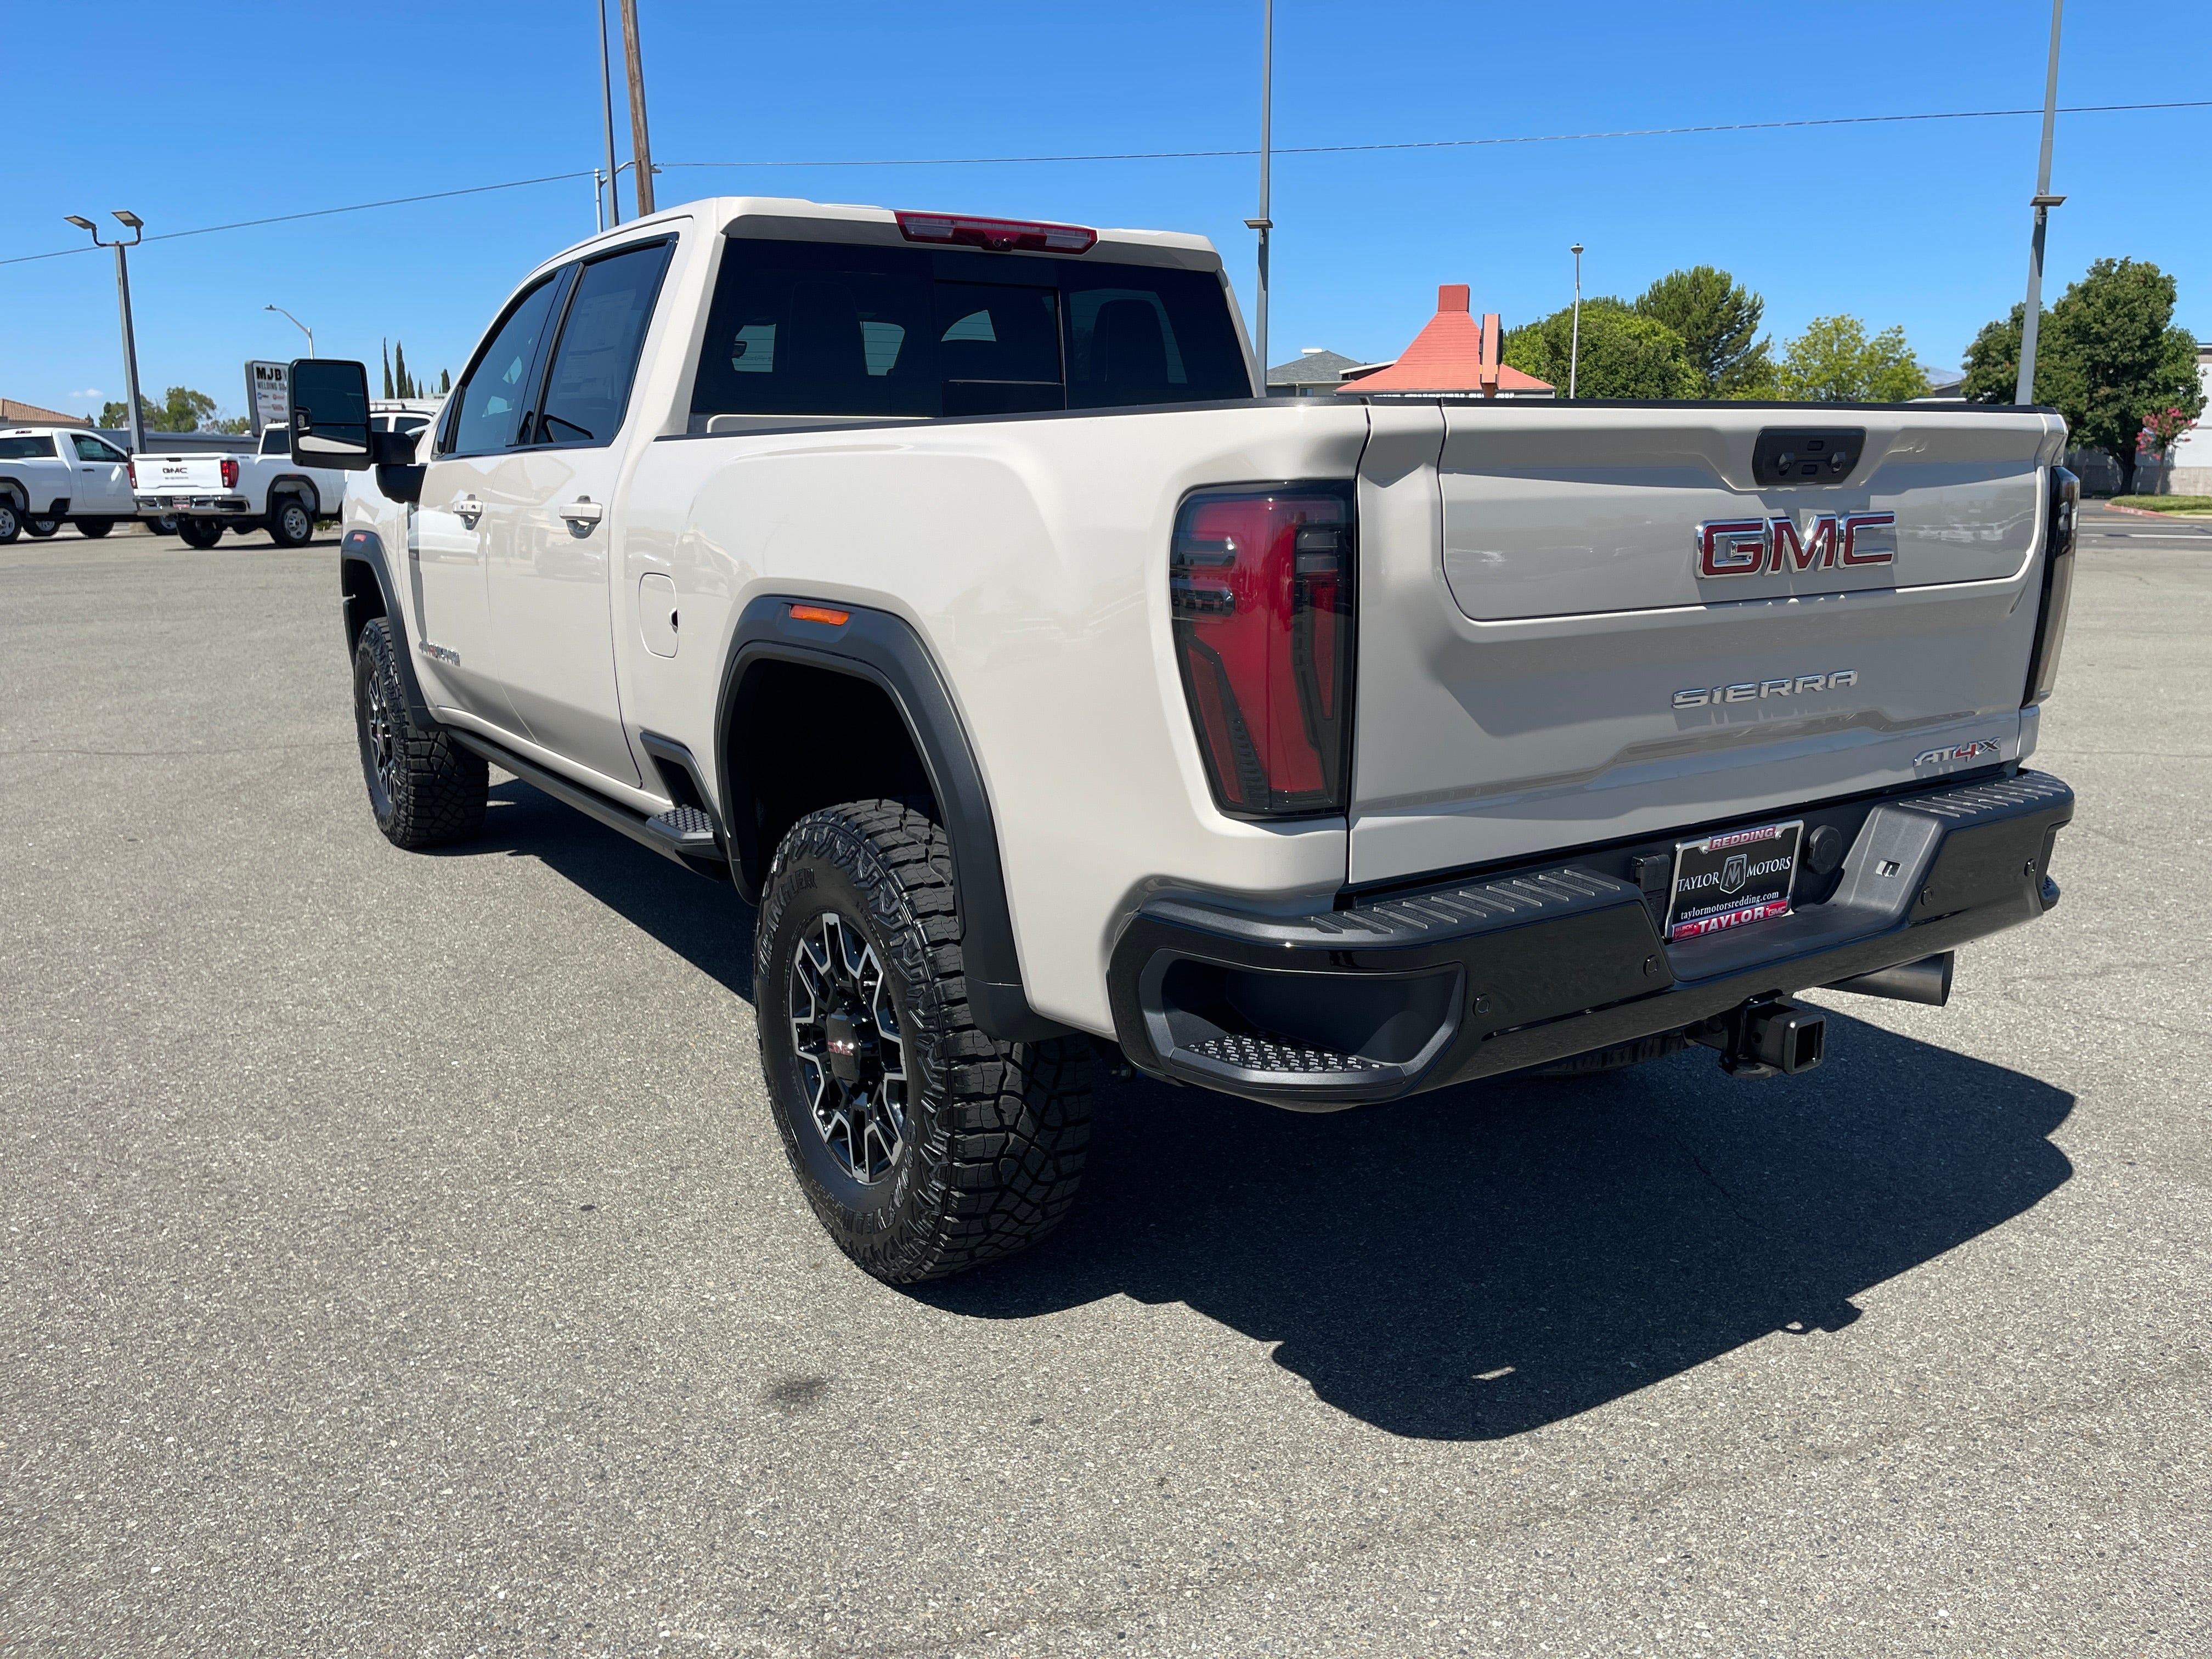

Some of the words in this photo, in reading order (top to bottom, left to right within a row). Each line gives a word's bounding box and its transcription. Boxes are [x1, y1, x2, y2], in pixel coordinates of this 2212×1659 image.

[256, 366, 281, 380] MJB
[1695, 511, 1895, 579] GMC
[1672, 669, 1858, 709] SIERRA
[1914, 737, 2001, 767] AT4X
[1711, 828, 1774, 849] REDDING
[1678, 872, 1719, 892] TAYLOR
[1747, 856, 1791, 878] MOTORS
[1675, 924, 1694, 932] BUICK
[1699, 906, 1765, 933] TAYLOR
[1768, 906, 1786, 917] GMC
[1681, 891, 1779, 920] taylormotorsredding.com
